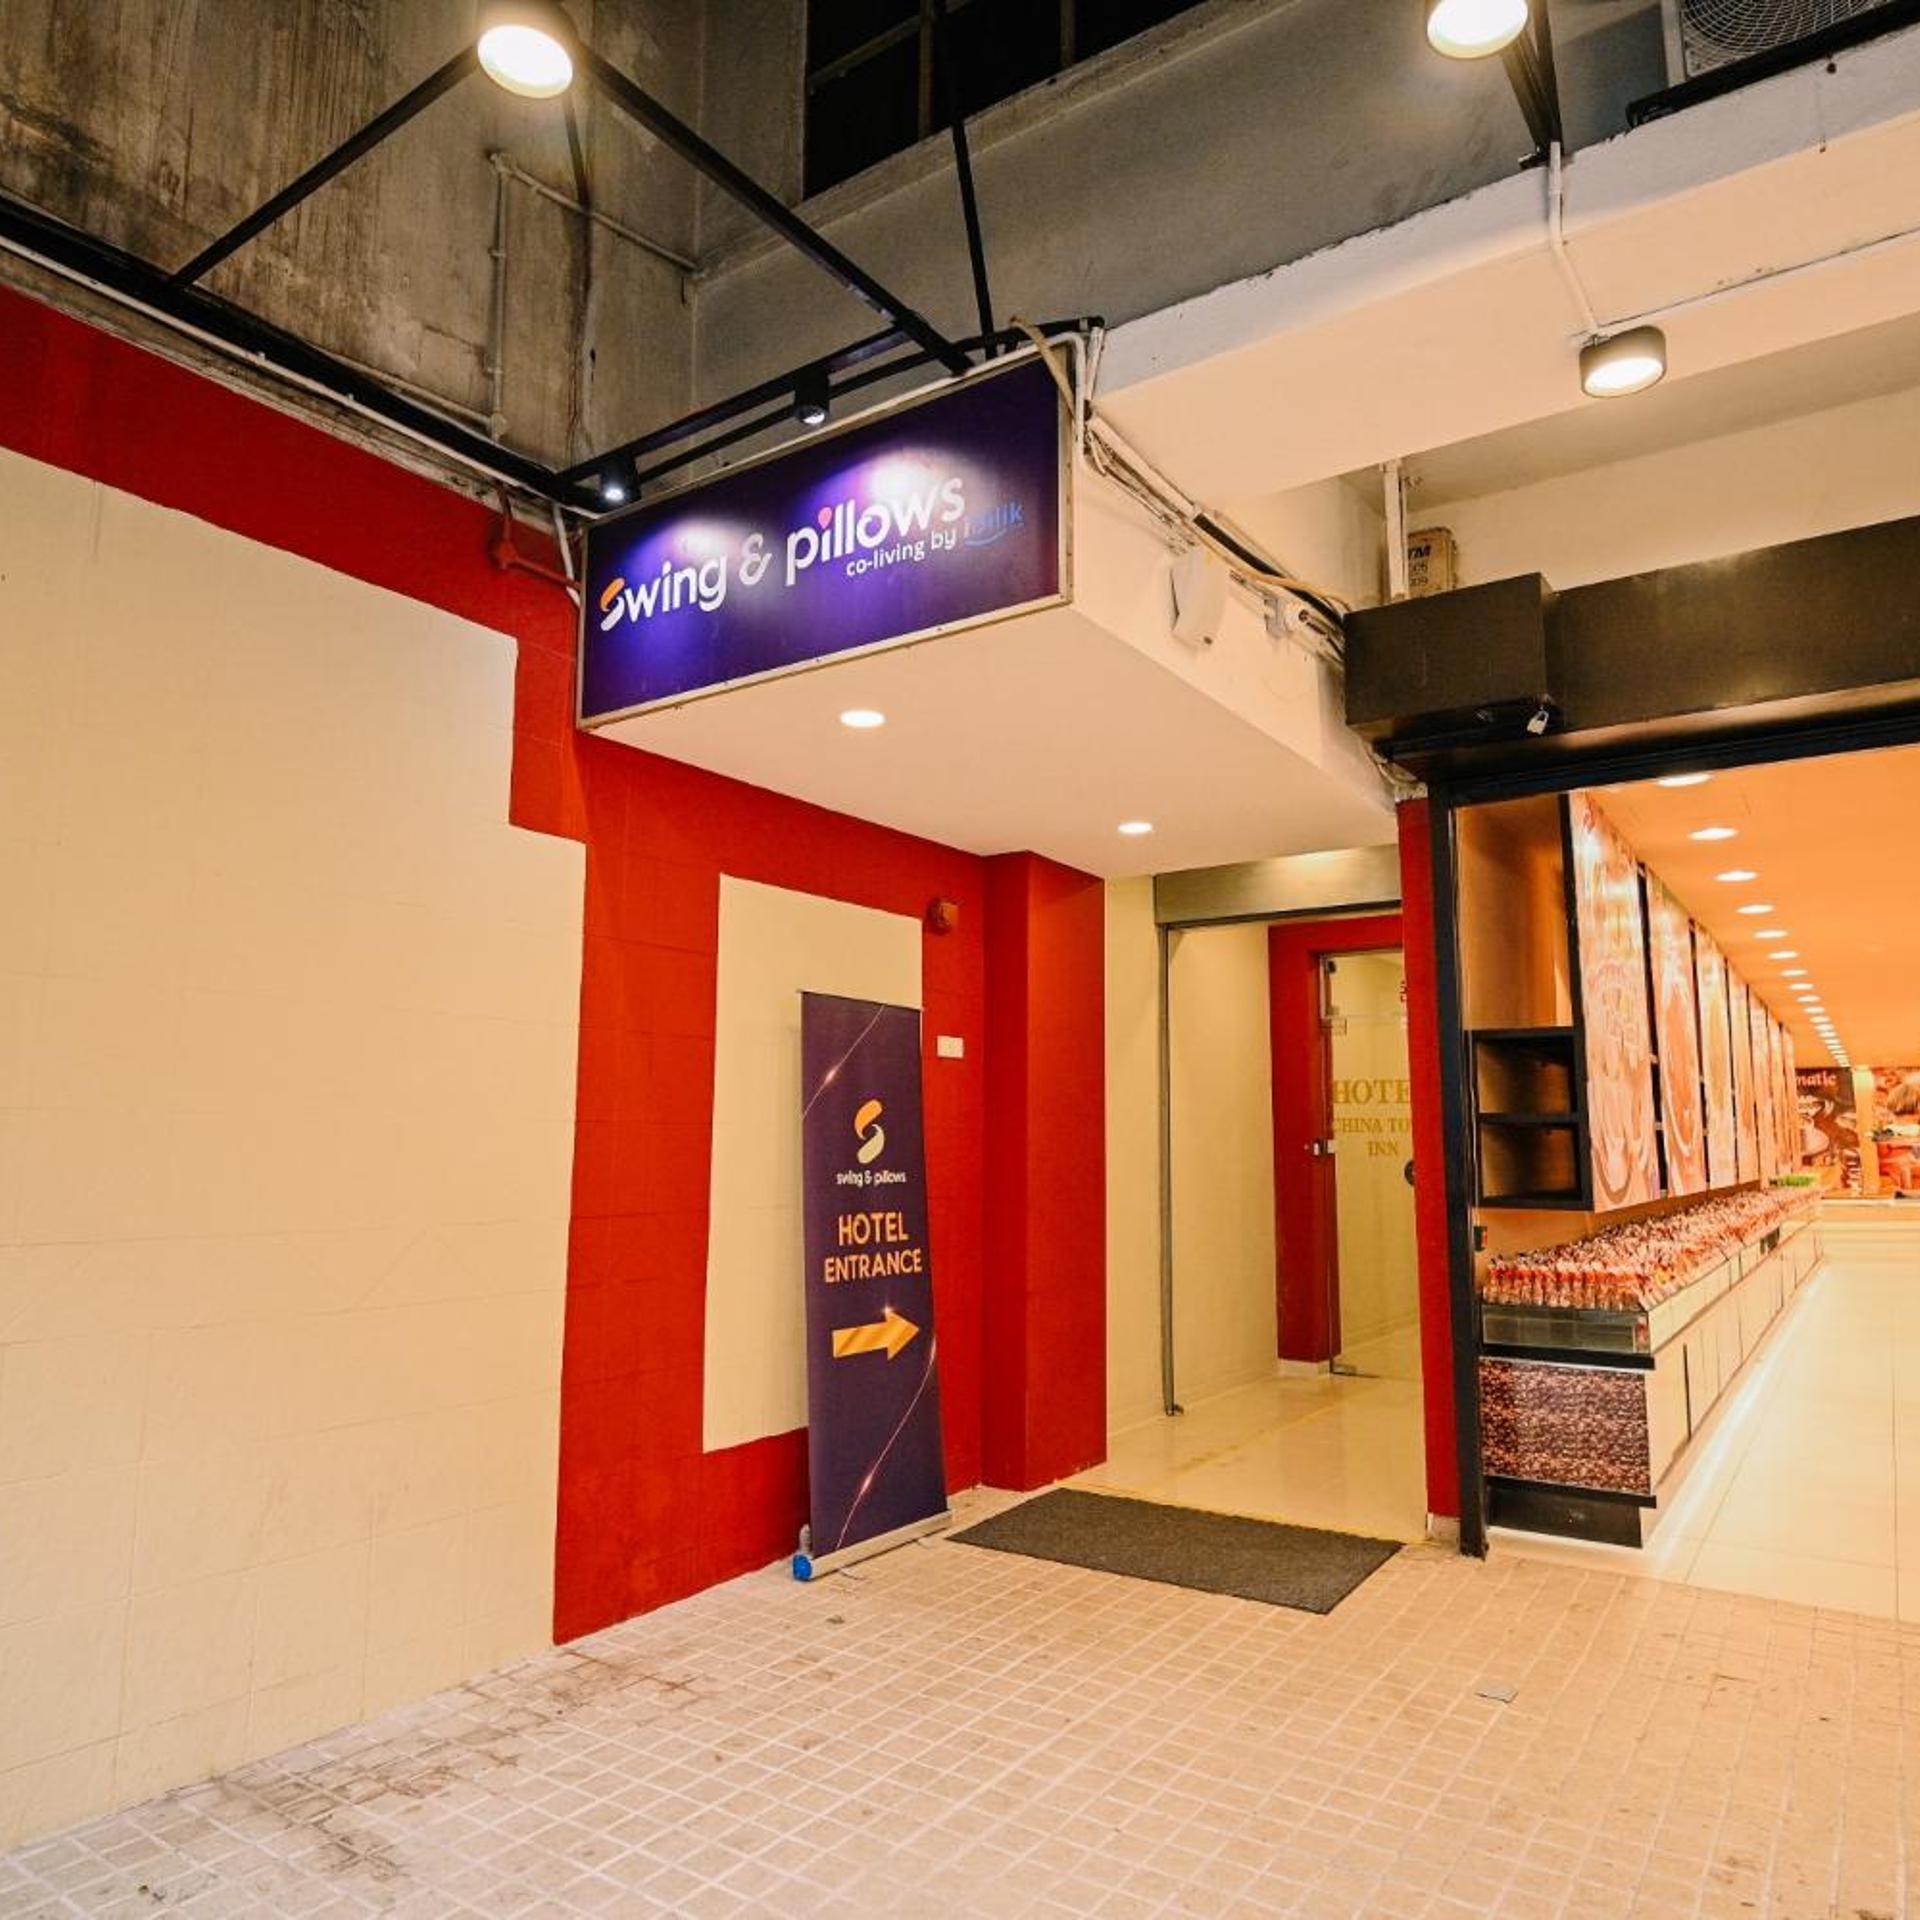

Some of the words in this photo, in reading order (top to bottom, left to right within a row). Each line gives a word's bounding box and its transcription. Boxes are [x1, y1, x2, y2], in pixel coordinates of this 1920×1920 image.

[738, 532, 773, 586] &
[785, 477, 966, 587] pillows
[846, 541, 925, 577] co-living
[931, 528, 957, 551] by
[1332, 1079, 1409, 1104] HOTE
[1387, 1117, 1410, 1134] TO
[1367, 1140, 1398, 1156] INN
[864, 1169, 873, 1185] &
[838, 1211, 909, 1246] HOTEL
[824, 1247, 922, 1283] ENTRANCE
